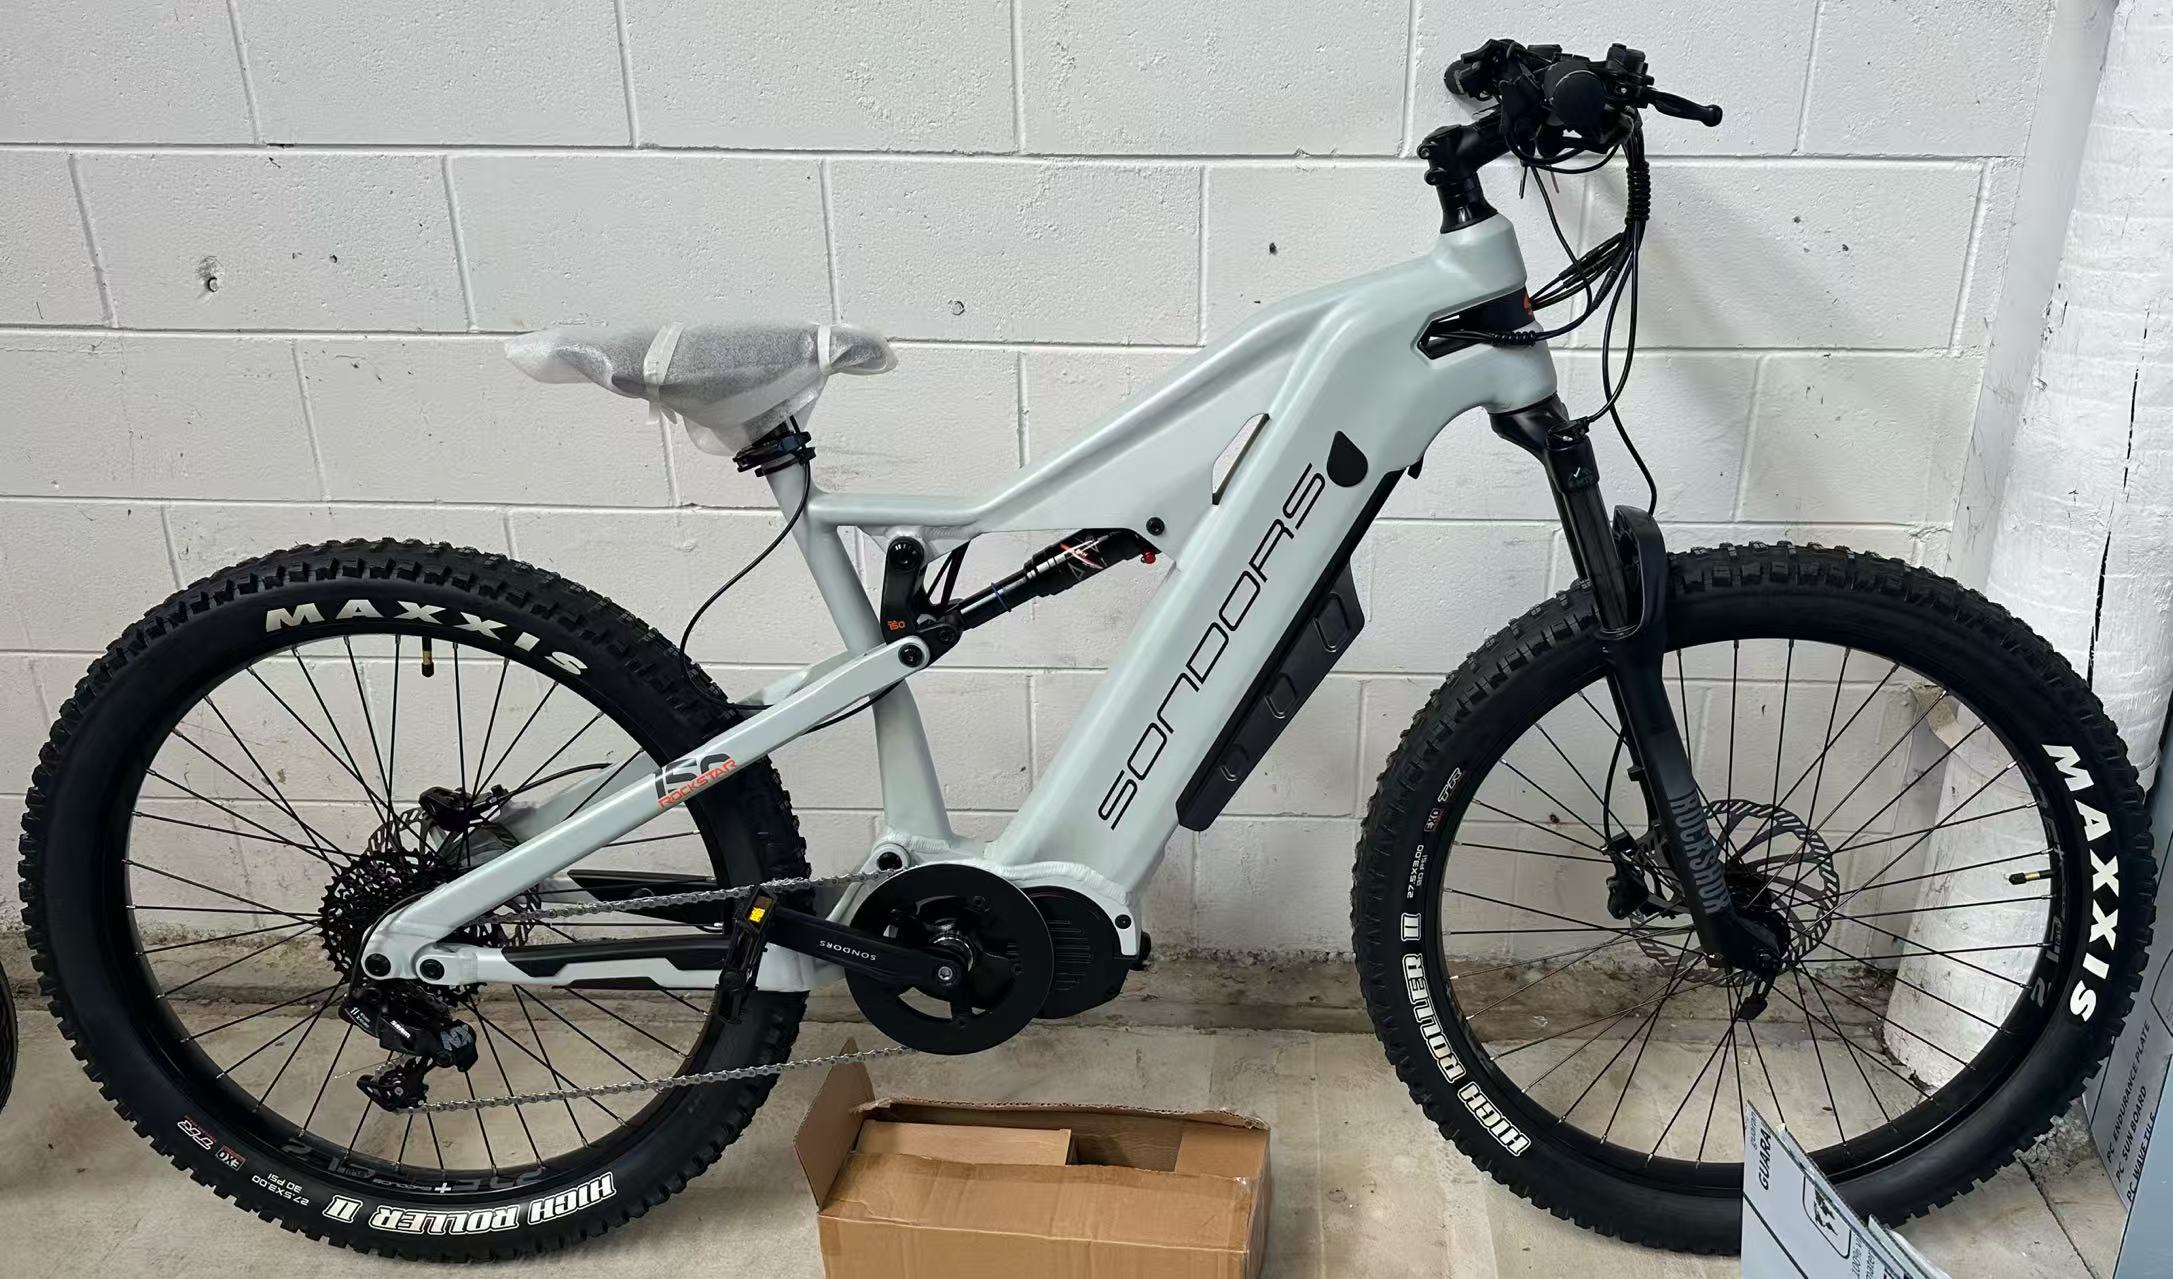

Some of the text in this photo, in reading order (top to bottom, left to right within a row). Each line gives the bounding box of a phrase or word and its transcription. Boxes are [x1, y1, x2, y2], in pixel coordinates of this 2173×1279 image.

[266, 599, 588, 675] MAXXIS
[1098, 462, 1326, 830] SONDORS
[657, 757, 736, 810] ROCKSTAR
[1670, 789, 1732, 914] ROCKSHOX
[2041, 744, 2119, 1021] MAXXIS
[819, 940, 877, 961] SONDORS
[1400, 912, 1531, 1156] HIGH ROLLER II
[2106, 1020, 2151, 1164] PC ENDURANCE PLATE
[177, 1119, 215, 1150] TR
[216, 1150, 241, 1170] EXO
[2116, 1086, 2147, 1183] PC SUN BOARD
[267, 1173, 303, 1194] 30 PSI
[527, 1171, 616, 1224] HIGH
[2126, 1182, 2137, 1202] PC
[2133, 1142, 2147, 1177] WAVE
[322, 1194, 363, 1224] II
[368, 1204, 520, 1236] ROLLER
